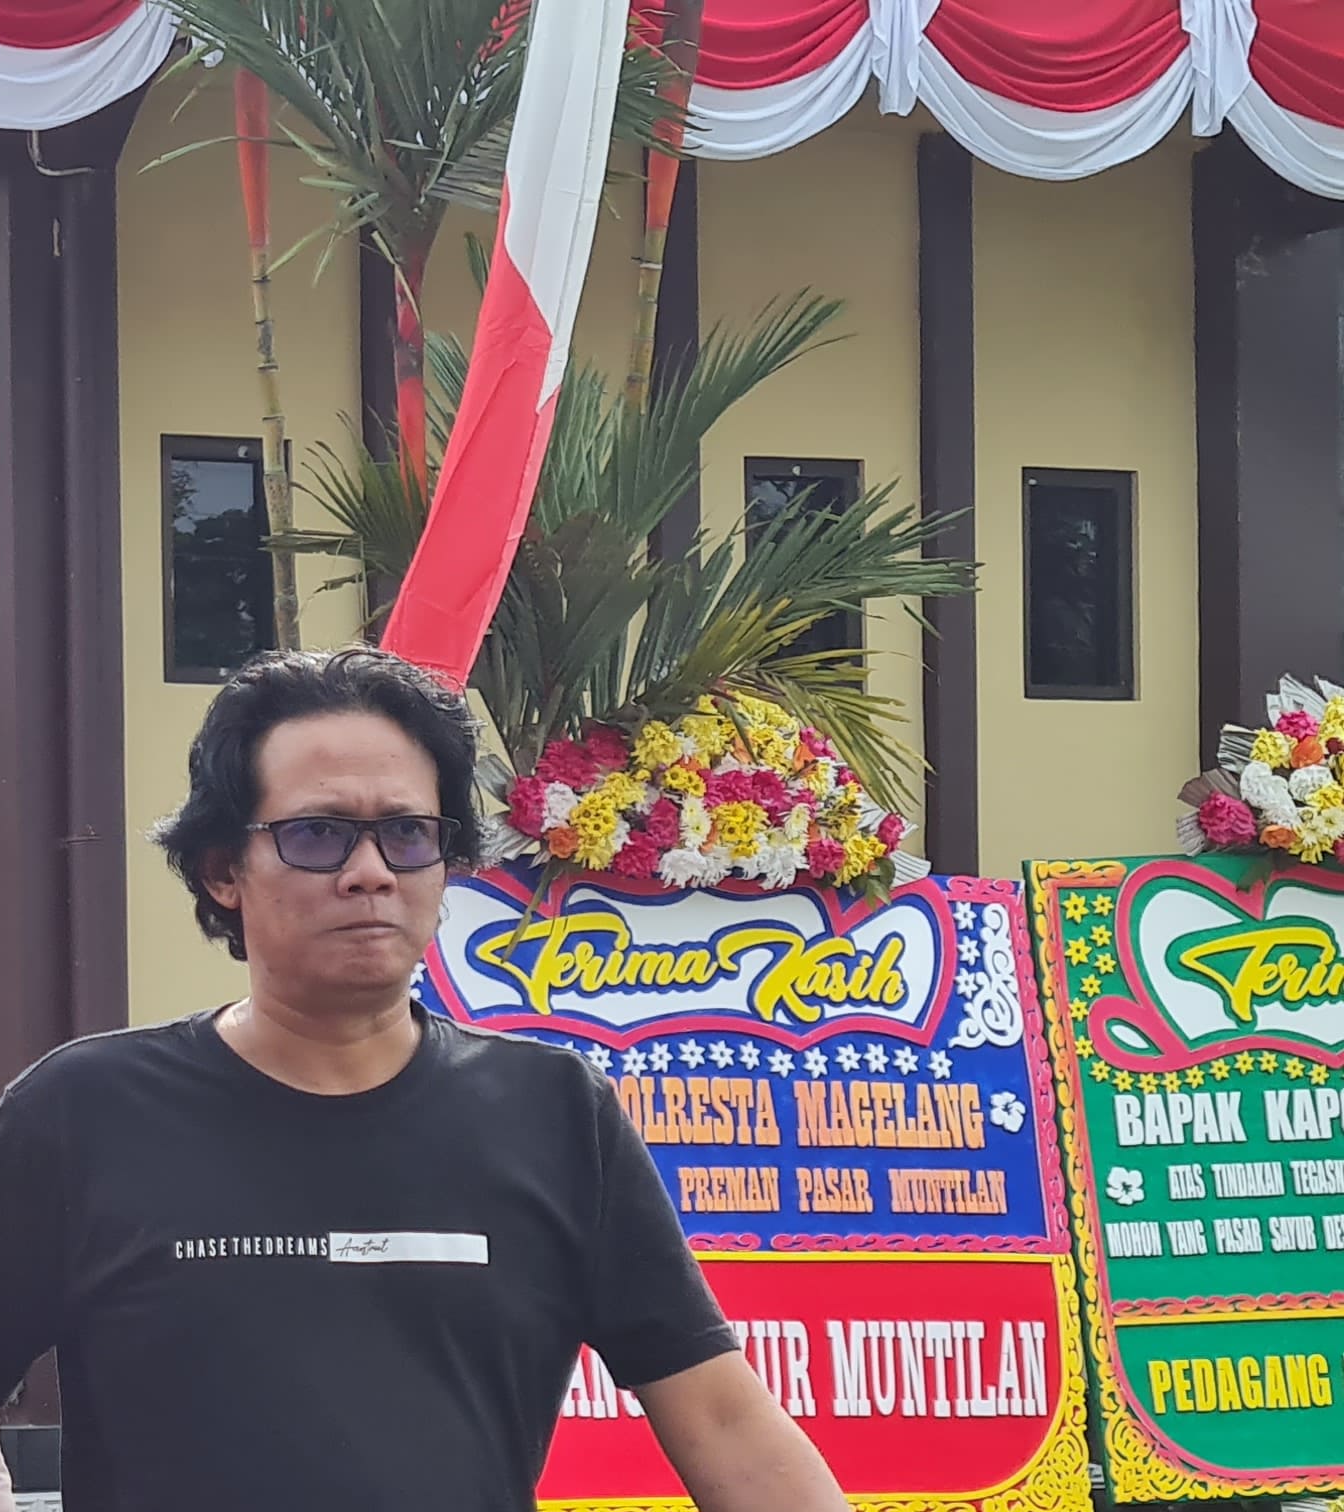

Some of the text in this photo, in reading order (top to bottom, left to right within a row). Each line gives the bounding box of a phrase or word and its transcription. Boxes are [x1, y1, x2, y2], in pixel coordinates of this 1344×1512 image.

[475, 912, 907, 1023] Terima Kasih
[609, 1075, 985, 1149] OLRESTA MAGELANG
[1114, 1088, 1344, 1147] BAPAK KAP
[678, 1166, 1008, 1215] PREMAN PASAR MUNTILAN
[1168, 1163, 1206, 1200] ATAS
[1211, 1161, 1285, 1198] TINDAKAN
[176, 1238, 227, 1260] CHASE
[1105, 1221, 1162, 1257] MOHON
[1166, 1219, 1208, 1256] YANG
[1213, 1218, 1263, 1254] PASAR
[1269, 1216, 1317, 1252] SAYUR
[825, 1320, 1048, 1418] MUNTILAN
[1147, 1353, 1333, 1415] PEDAGANG
